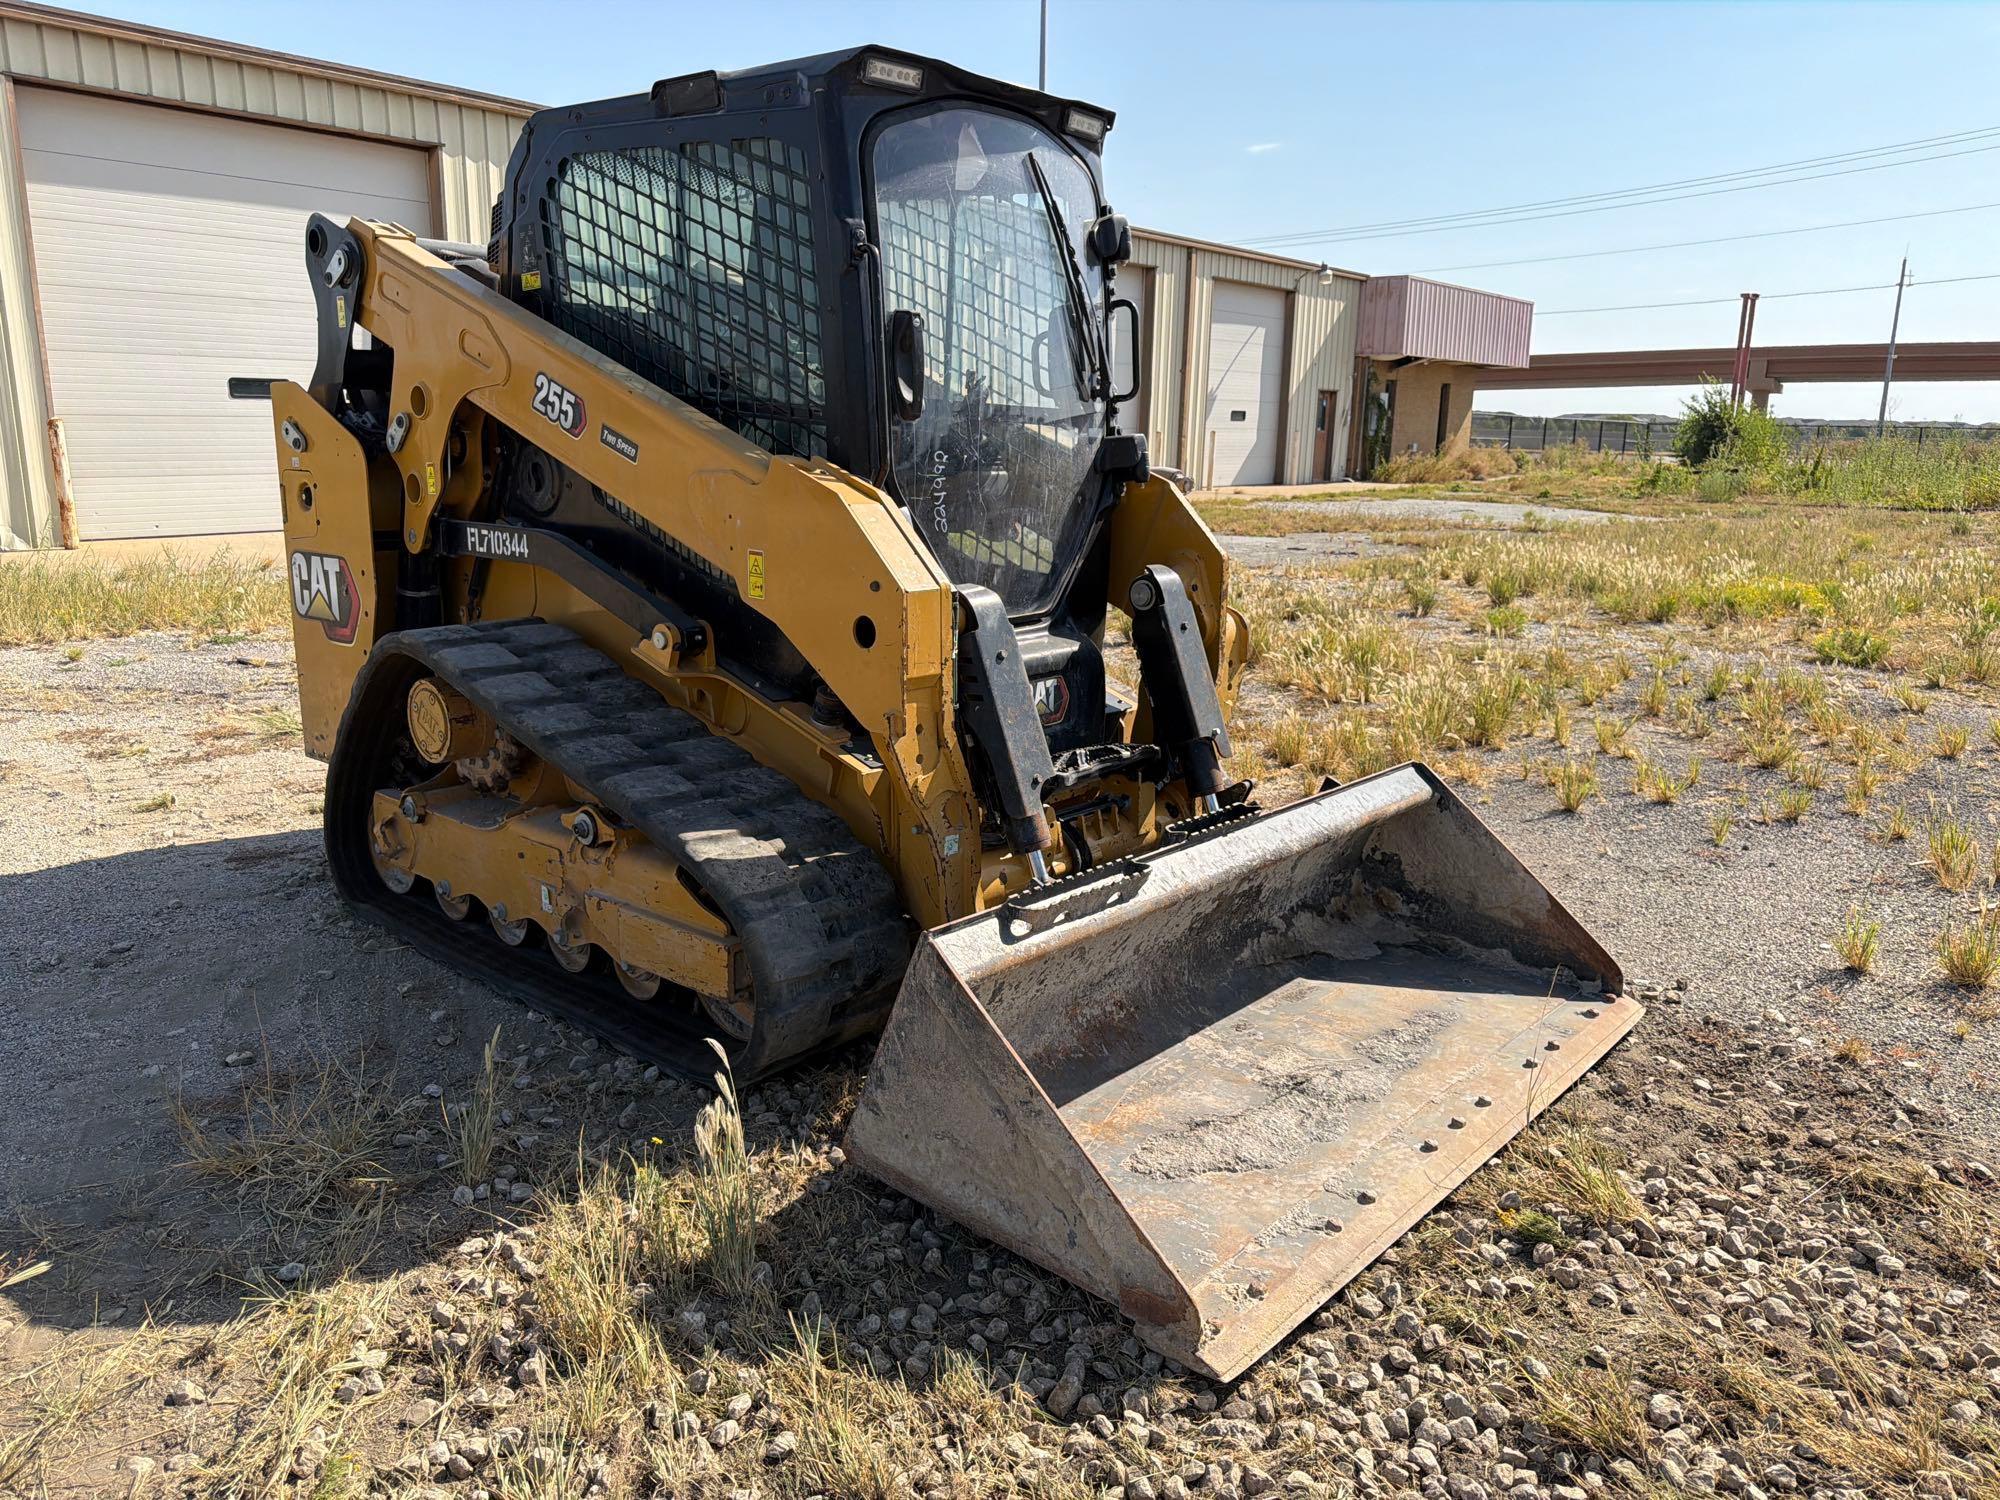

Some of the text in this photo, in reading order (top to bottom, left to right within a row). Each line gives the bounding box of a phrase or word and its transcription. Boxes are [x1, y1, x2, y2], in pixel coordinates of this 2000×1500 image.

[533, 374, 576, 429] 255
[466, 526, 529, 558] FL710344
[291, 552, 341, 622] CAT
[1034, 678, 1058, 712] AT
